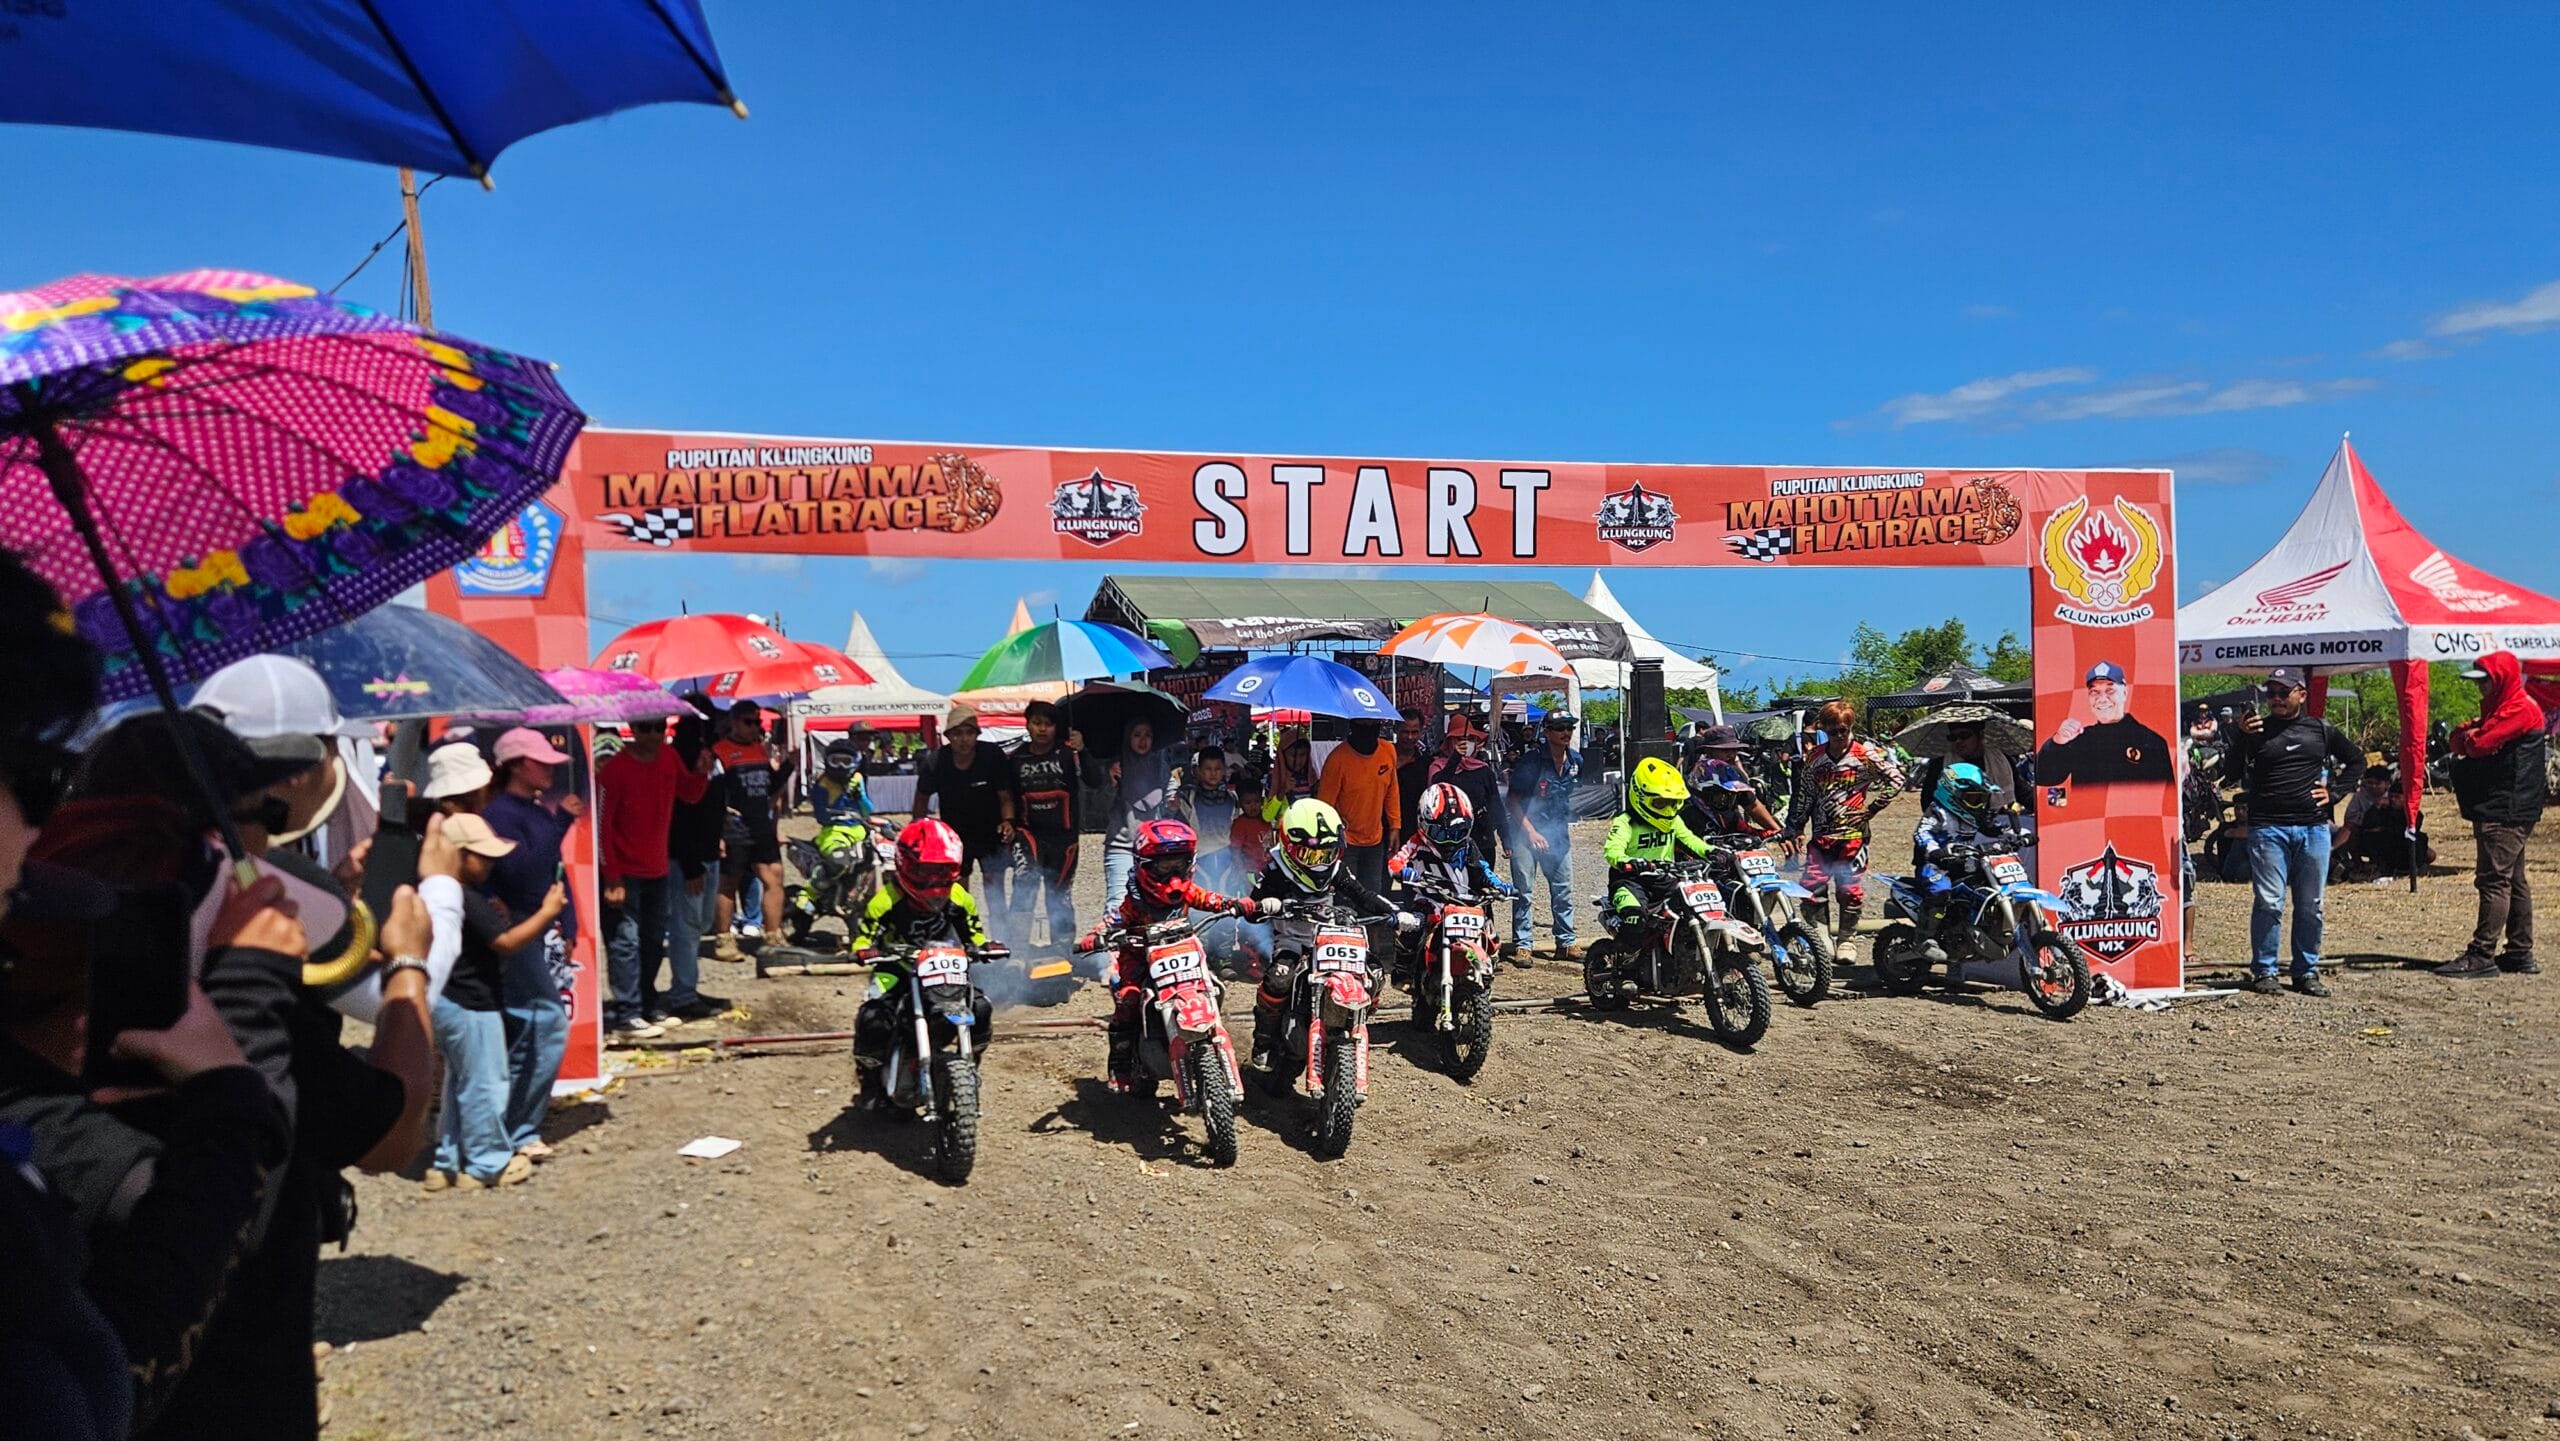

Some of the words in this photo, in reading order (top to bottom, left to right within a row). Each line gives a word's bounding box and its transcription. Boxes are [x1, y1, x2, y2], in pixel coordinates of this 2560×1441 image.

[667, 449, 755, 470] PUPUTAN
[759, 446, 873, 467] KLUNGKUNG
[605, 463, 949, 507] MAHOTTAMA
[1772, 477, 1837, 496] PUPUTAN
[1840, 472, 1925, 491] KLUNGKUNG
[1192, 461, 1550, 556] START
[1728, 485, 1981, 530] MAHOTTAMA
[700, 497, 949, 537] FLATRACE
[1056, 518, 1139, 533] KLUNGKUNG
[1086, 531, 1110, 540] MX
[1601, 528, 1672, 540] KLUNGKUNG
[1793, 515, 1982, 554] FLATRACE
[1626, 539, 1647, 547] MX
[2058, 606, 2151, 625] KLUNGKUNG
[2244, 602, 2326, 614] HONDA
[2226, 616, 2261, 626] One
[1236, 629, 1254, 638] Let
[1275, 623, 1306, 634] Good
[1541, 626, 1599, 642] saki
[2215, 642, 2315, 660] CEMERLANG
[2320, 640, 2383, 655] MOTOR
[2504, 637, 2560, 649] CEMERLA
[912, 703, 944, 711] MOTOR
[1192, 708, 1213, 722] 2026
[1638, 830, 1675, 850] SHOT
[1746, 858, 1768, 866] 124
[2000, 865, 2021, 873] 102
[1452, 916, 1479, 926] 141
[2062, 921, 2157, 941] KLUNGKUNG
[1326, 947, 1358, 959] 065
[2098, 940, 2125, 951] MX
[928, 958, 961, 971] 106
[1158, 956, 1190, 973] 107
